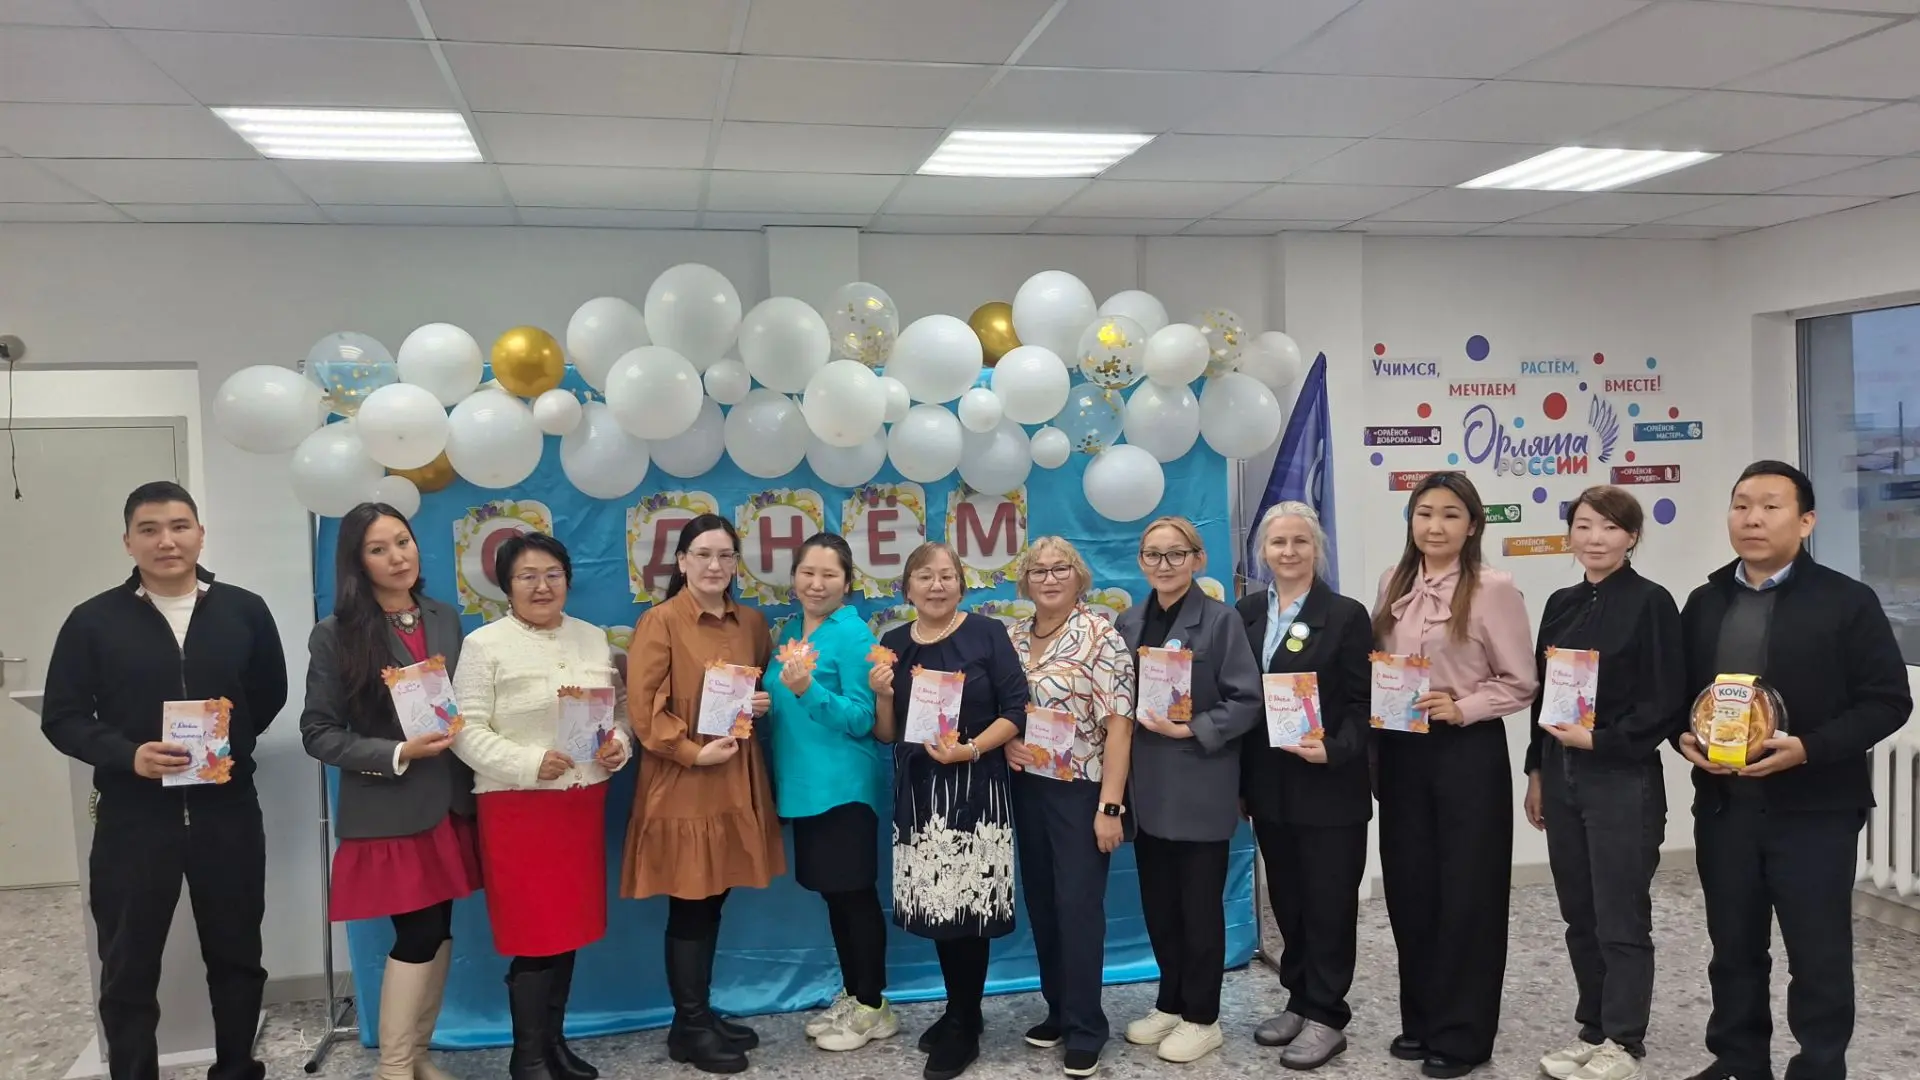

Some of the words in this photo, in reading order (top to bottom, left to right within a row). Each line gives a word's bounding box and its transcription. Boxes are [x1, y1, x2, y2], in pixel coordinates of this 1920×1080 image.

[1372, 359, 1440, 378] УЧИМСЯ,
[1520, 359, 1579, 375] РАСТЁМ,
[1449, 383, 1516, 396] МЕЧТАЕМ
[1605, 375, 1661, 392] ВМЕСТЕ!
[1463, 404, 1589, 470] Орлята
[1497, 456, 1588, 477] РОССИИ
